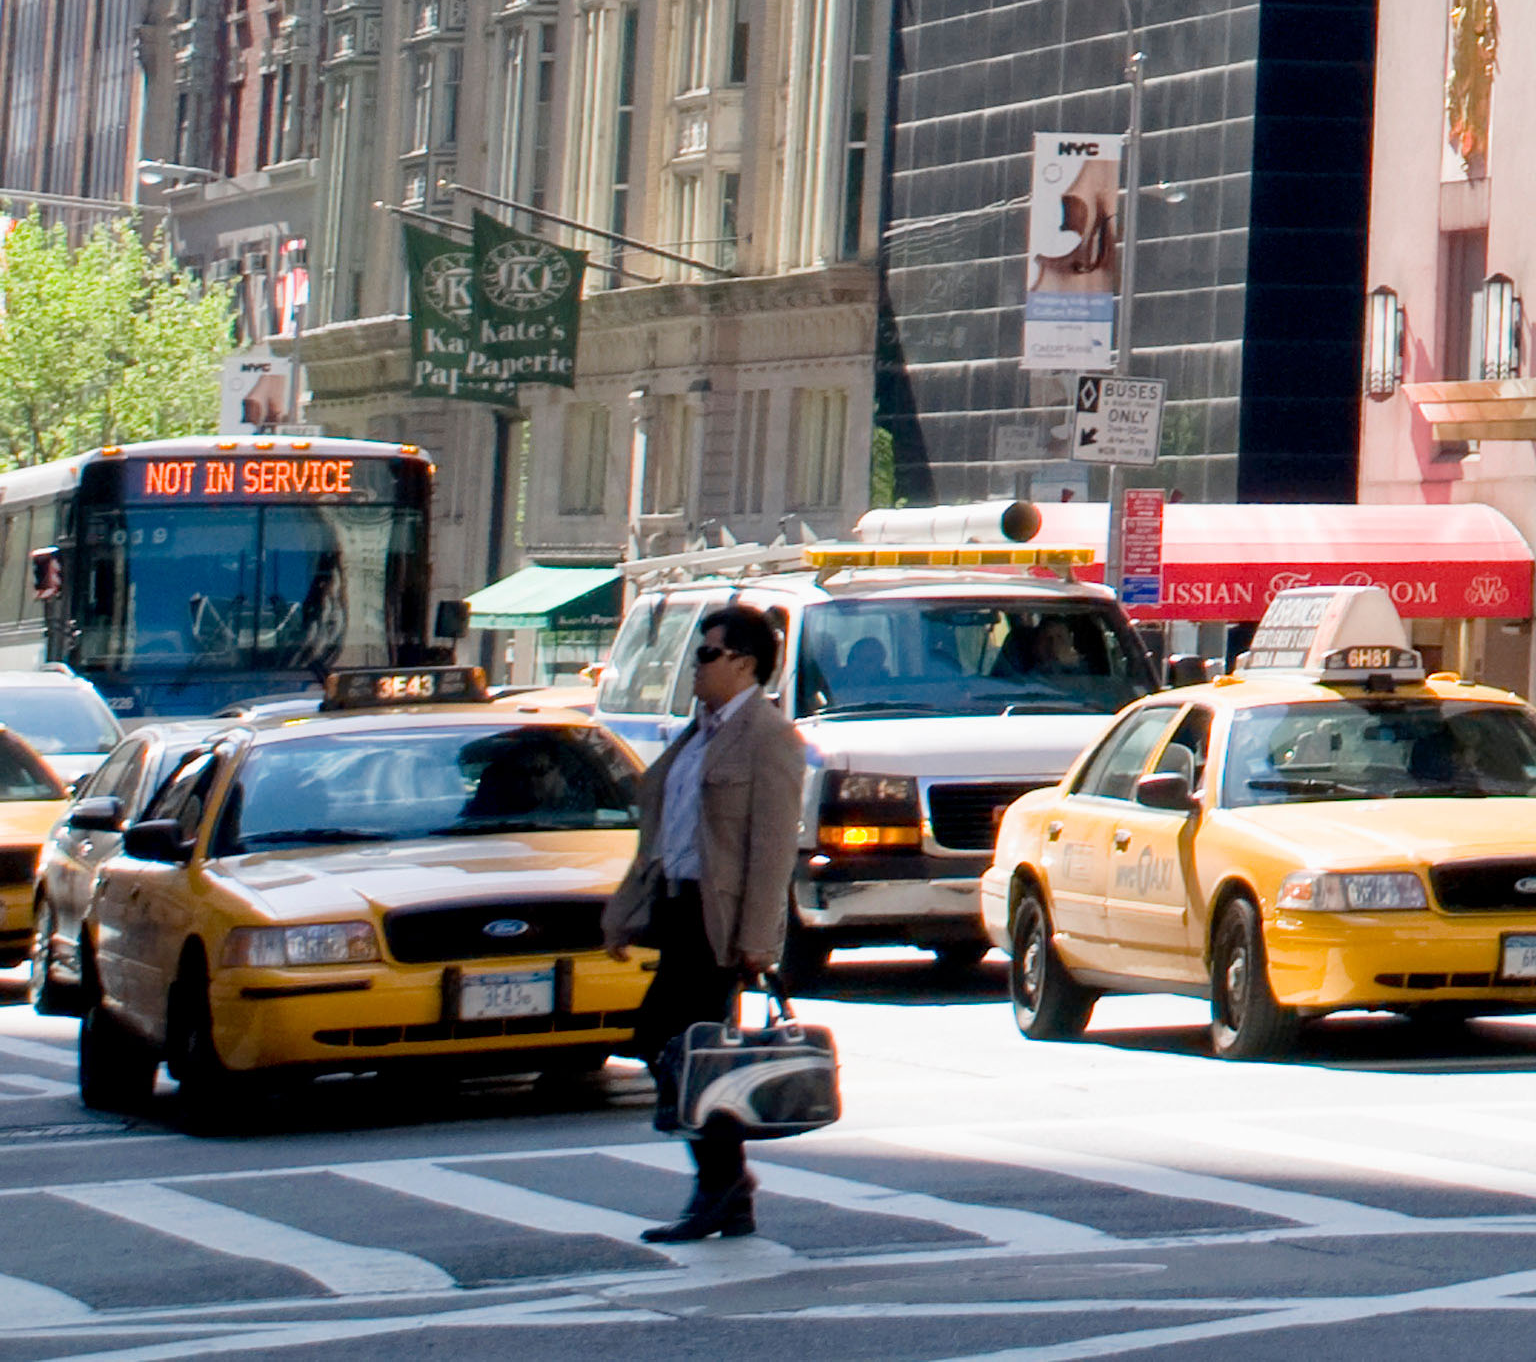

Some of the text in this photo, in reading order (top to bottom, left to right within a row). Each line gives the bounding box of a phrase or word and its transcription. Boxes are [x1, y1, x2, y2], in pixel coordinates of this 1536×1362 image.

[1059, 142, 1100, 156] NYC
[480, 316, 566, 344] Kate's
[240, 363, 271, 372] NYC
[466, 349, 572, 379] Paperie
[1105, 383, 1158, 399] BUSES
[1108, 409, 1148, 424] ONLY
[145, 460, 353, 494] NOT IN SERVICE
[1349, 648, 1391, 668] 6H81
[377, 675, 435, 699] 3E43
